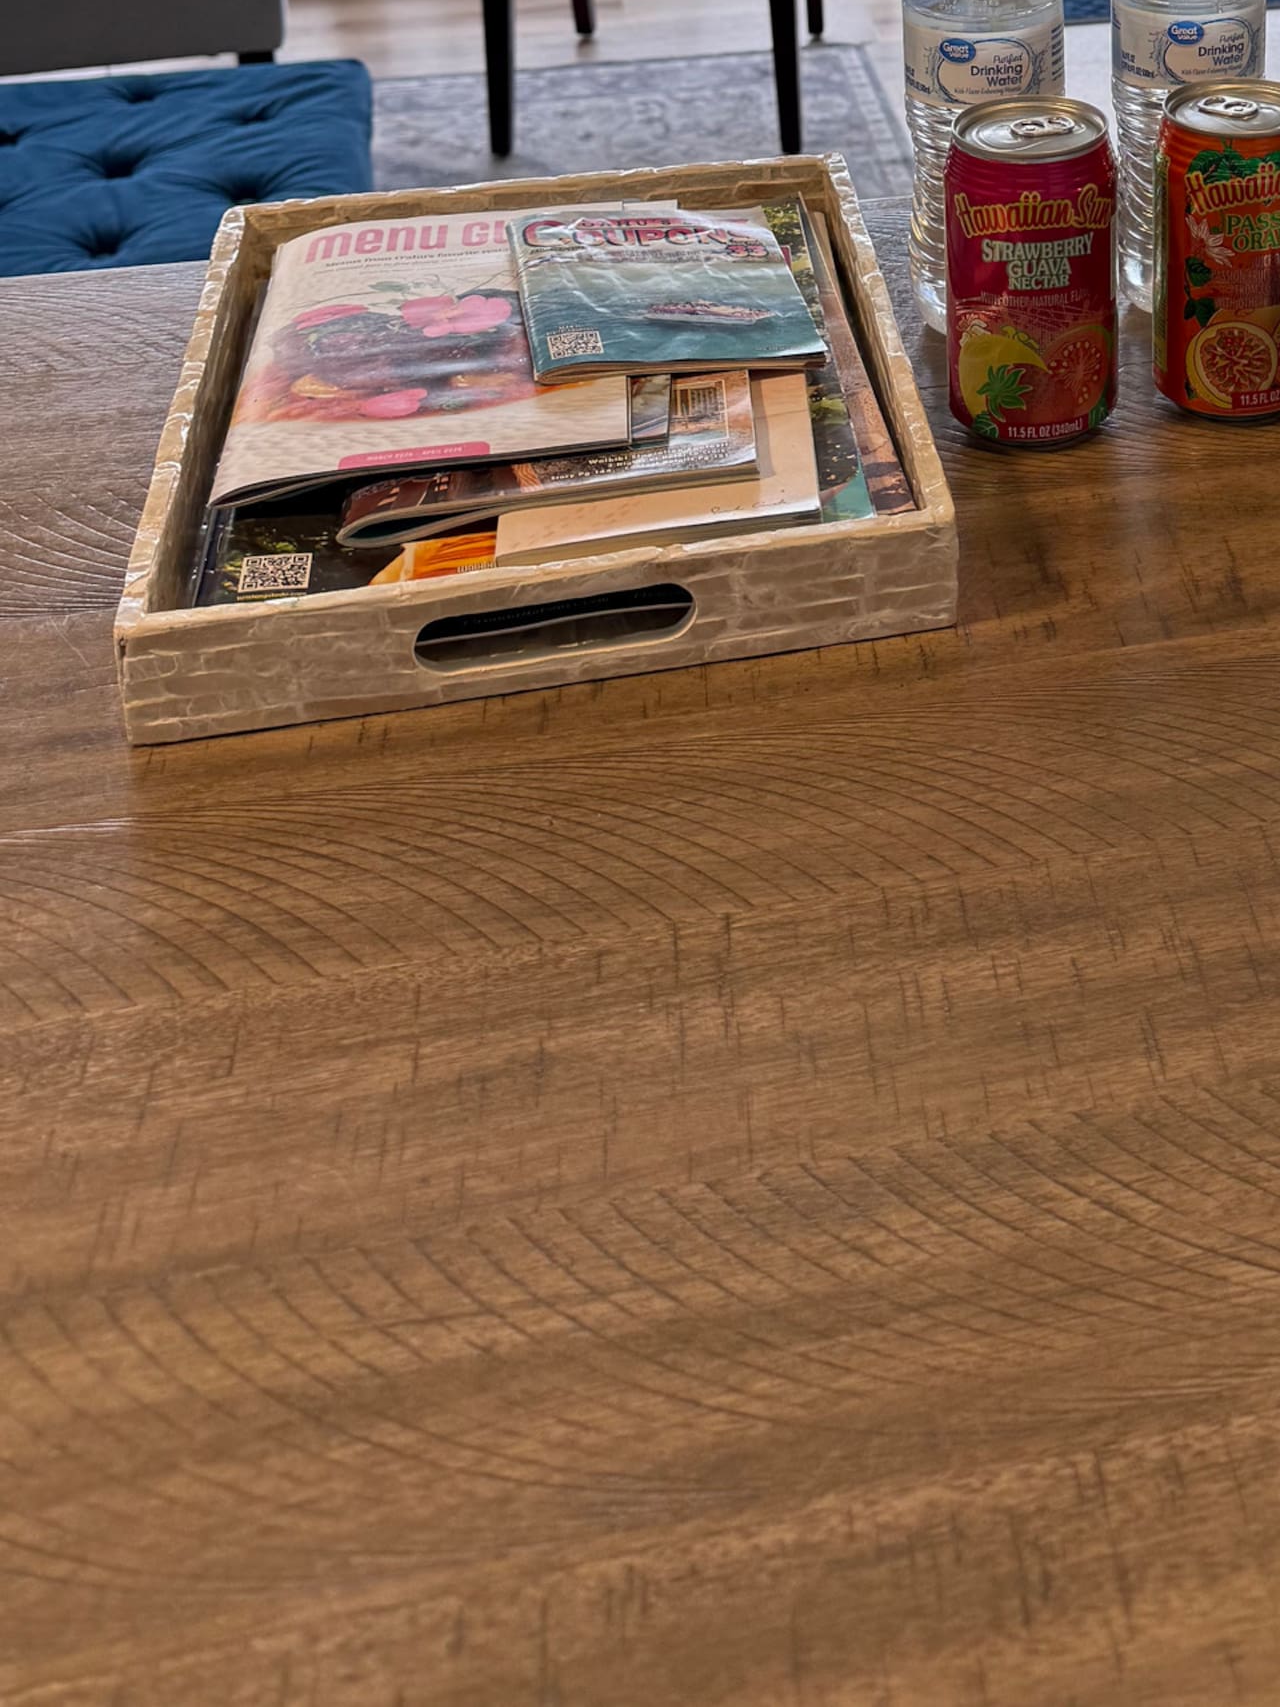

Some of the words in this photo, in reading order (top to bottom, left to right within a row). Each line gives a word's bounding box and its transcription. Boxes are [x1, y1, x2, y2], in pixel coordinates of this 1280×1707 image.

[1171, 25, 1198, 35] Great
[1198, 43, 1245, 57] Drinking
[993, 52, 1024, 65] Purified
[1212, 53, 1245, 67] Water
[970, 63, 1023, 77] Drinking
[986, 74, 1023, 87] Water
[954, 191, 1072, 238] Hawaiian
[305, 224, 448, 264] menu
[726, 244, 769, 258] 33
[981, 232, 1094, 262] STRAWBERRY
[1006, 257, 1072, 278] GUAVA
[1008, 275, 1070, 290] NECTAR
[1240, 393, 1258, 405] 11.5
[1259, 392, 1269, 404] FL
[1270, 390, 1280, 402] OZ
[1008, 425, 1026, 438] 11.5
[1027, 425, 1038, 438] FL
[1039, 423, 1051, 437] OZ
